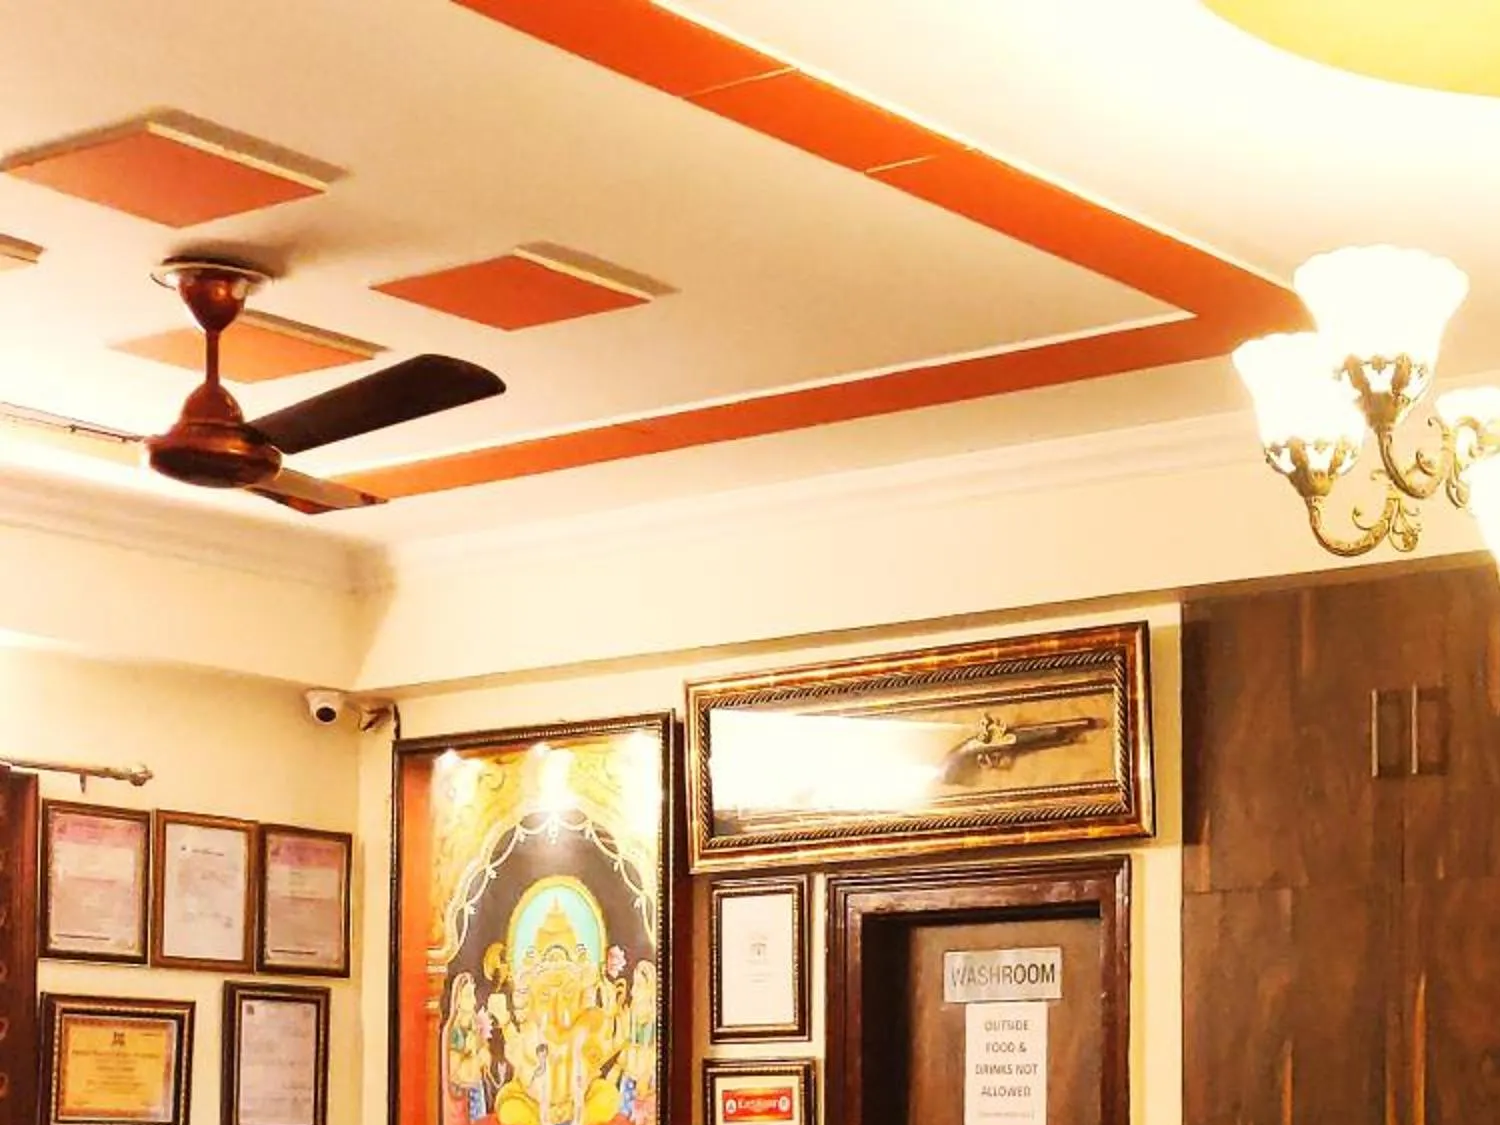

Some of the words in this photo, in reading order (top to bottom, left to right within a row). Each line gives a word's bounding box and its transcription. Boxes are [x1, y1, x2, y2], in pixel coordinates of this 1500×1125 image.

[951, 963, 1055, 987] WASHROOM
[984, 1019, 1029, 1032] OUTSIDE
[986, 1041, 1015, 1054] FOOD
[975, 1064, 1012, 1075] DRINKS
[1015, 1063, 1038, 1075] NOT
[981, 1085, 1031, 1097] ALLOWED
